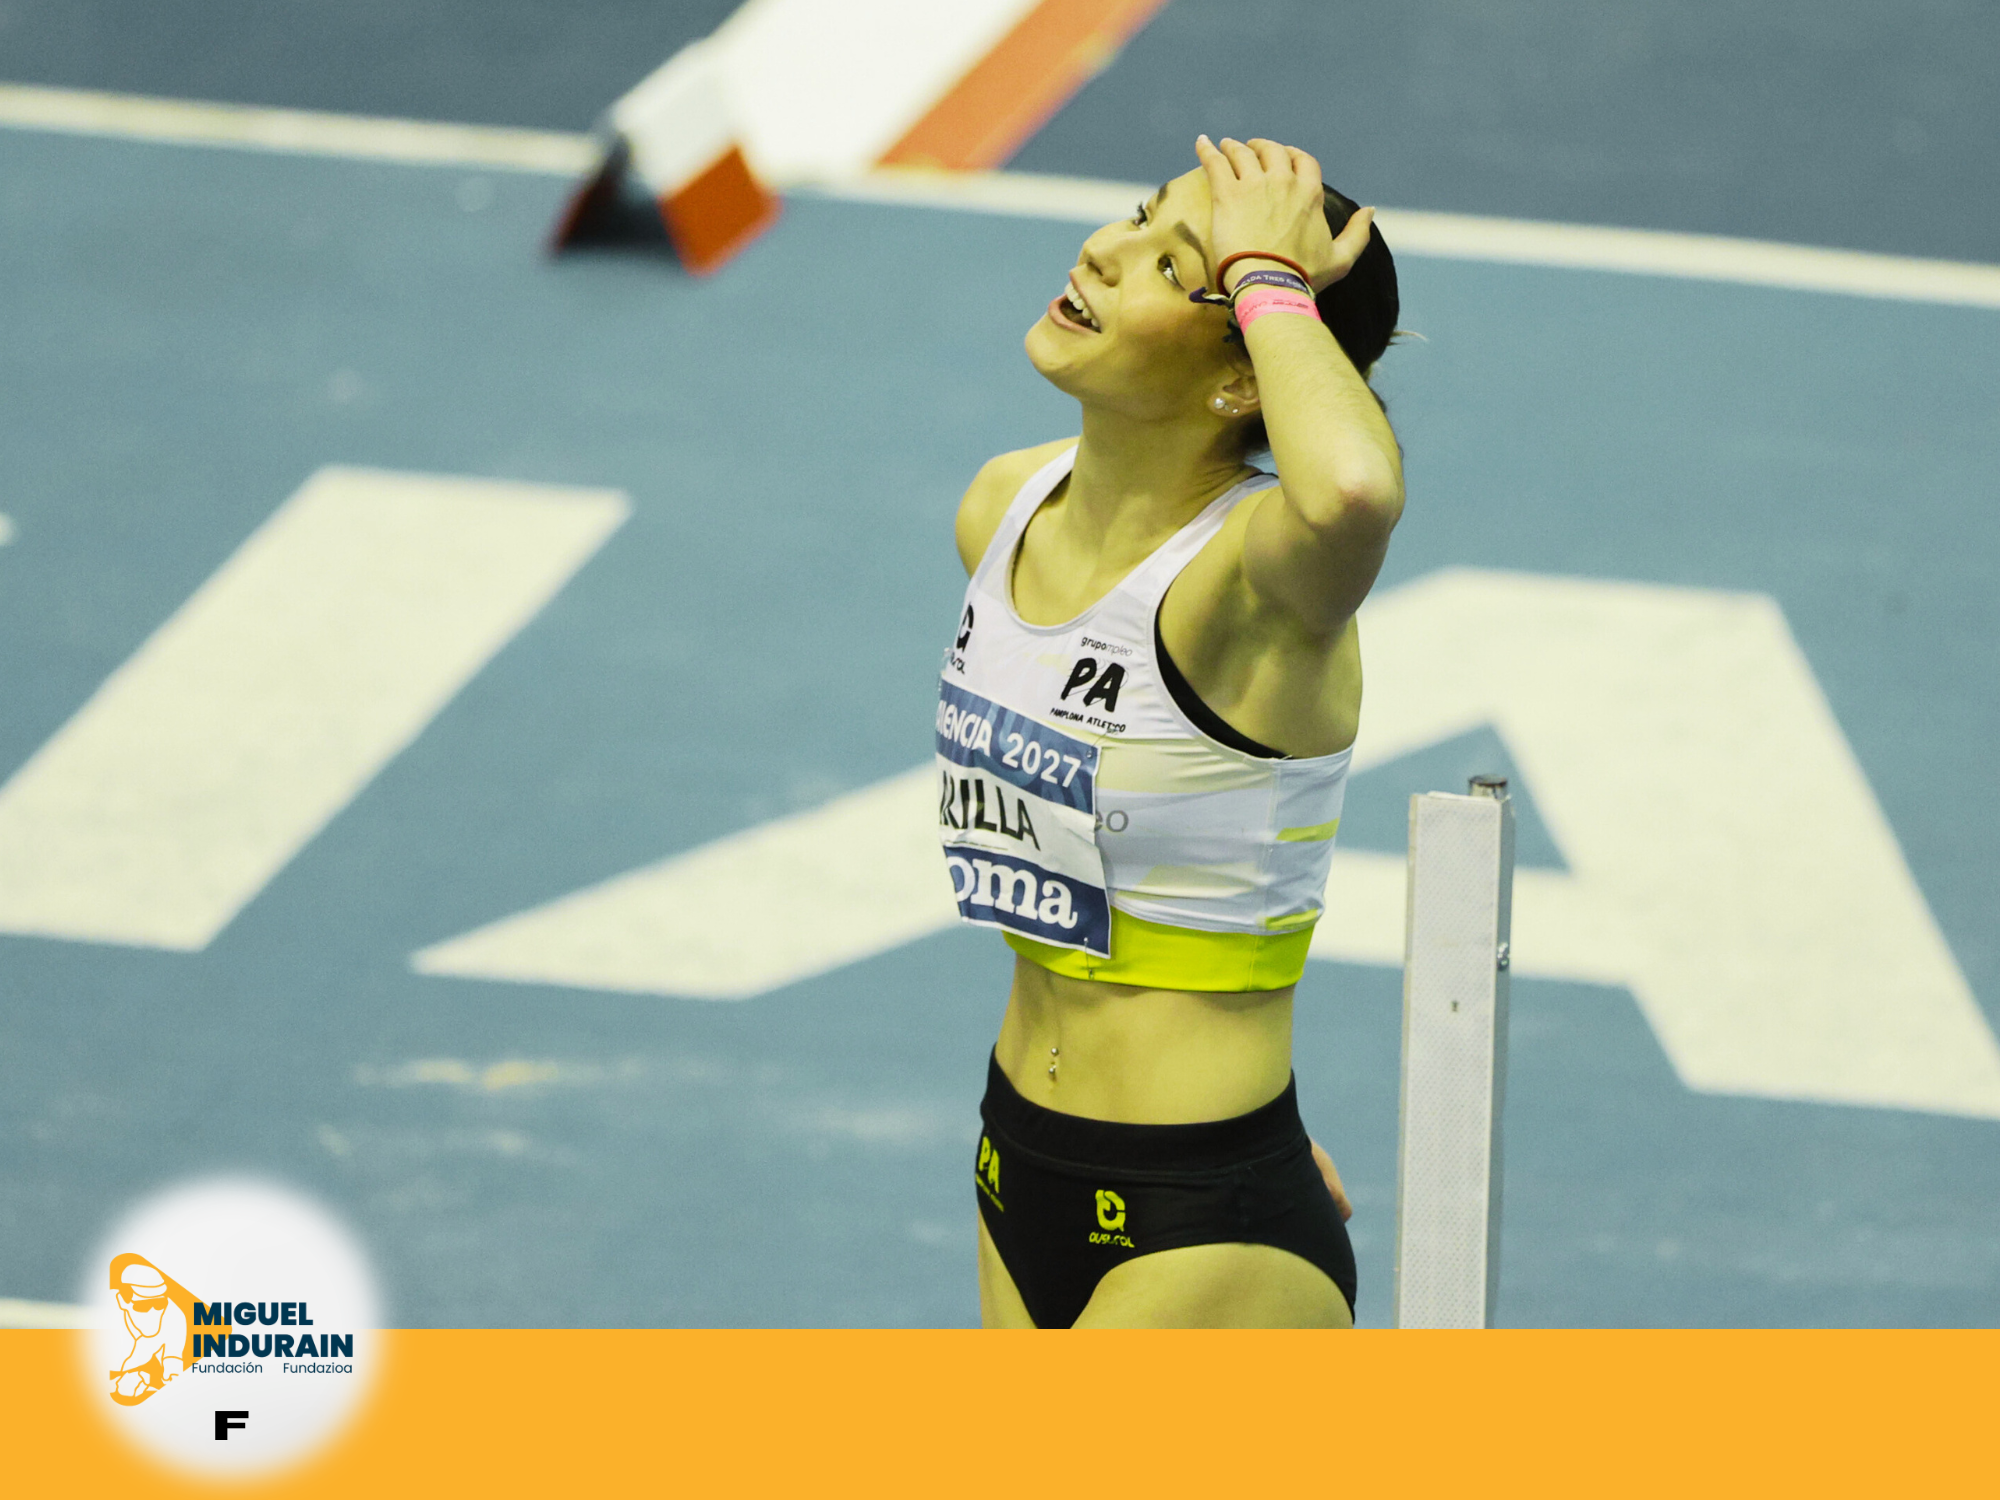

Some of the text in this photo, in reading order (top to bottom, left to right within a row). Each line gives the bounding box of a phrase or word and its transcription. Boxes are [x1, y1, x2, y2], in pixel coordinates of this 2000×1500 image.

[1060, 657, 1126, 713] PA
[1050, 707, 1084, 722] PAMPLONA
[1002, 732, 1082, 788] 2027
[940, 770, 1041, 851] RILLA
[948, 856, 1078, 930] oma
[978, 1136, 1000, 1194] PA
